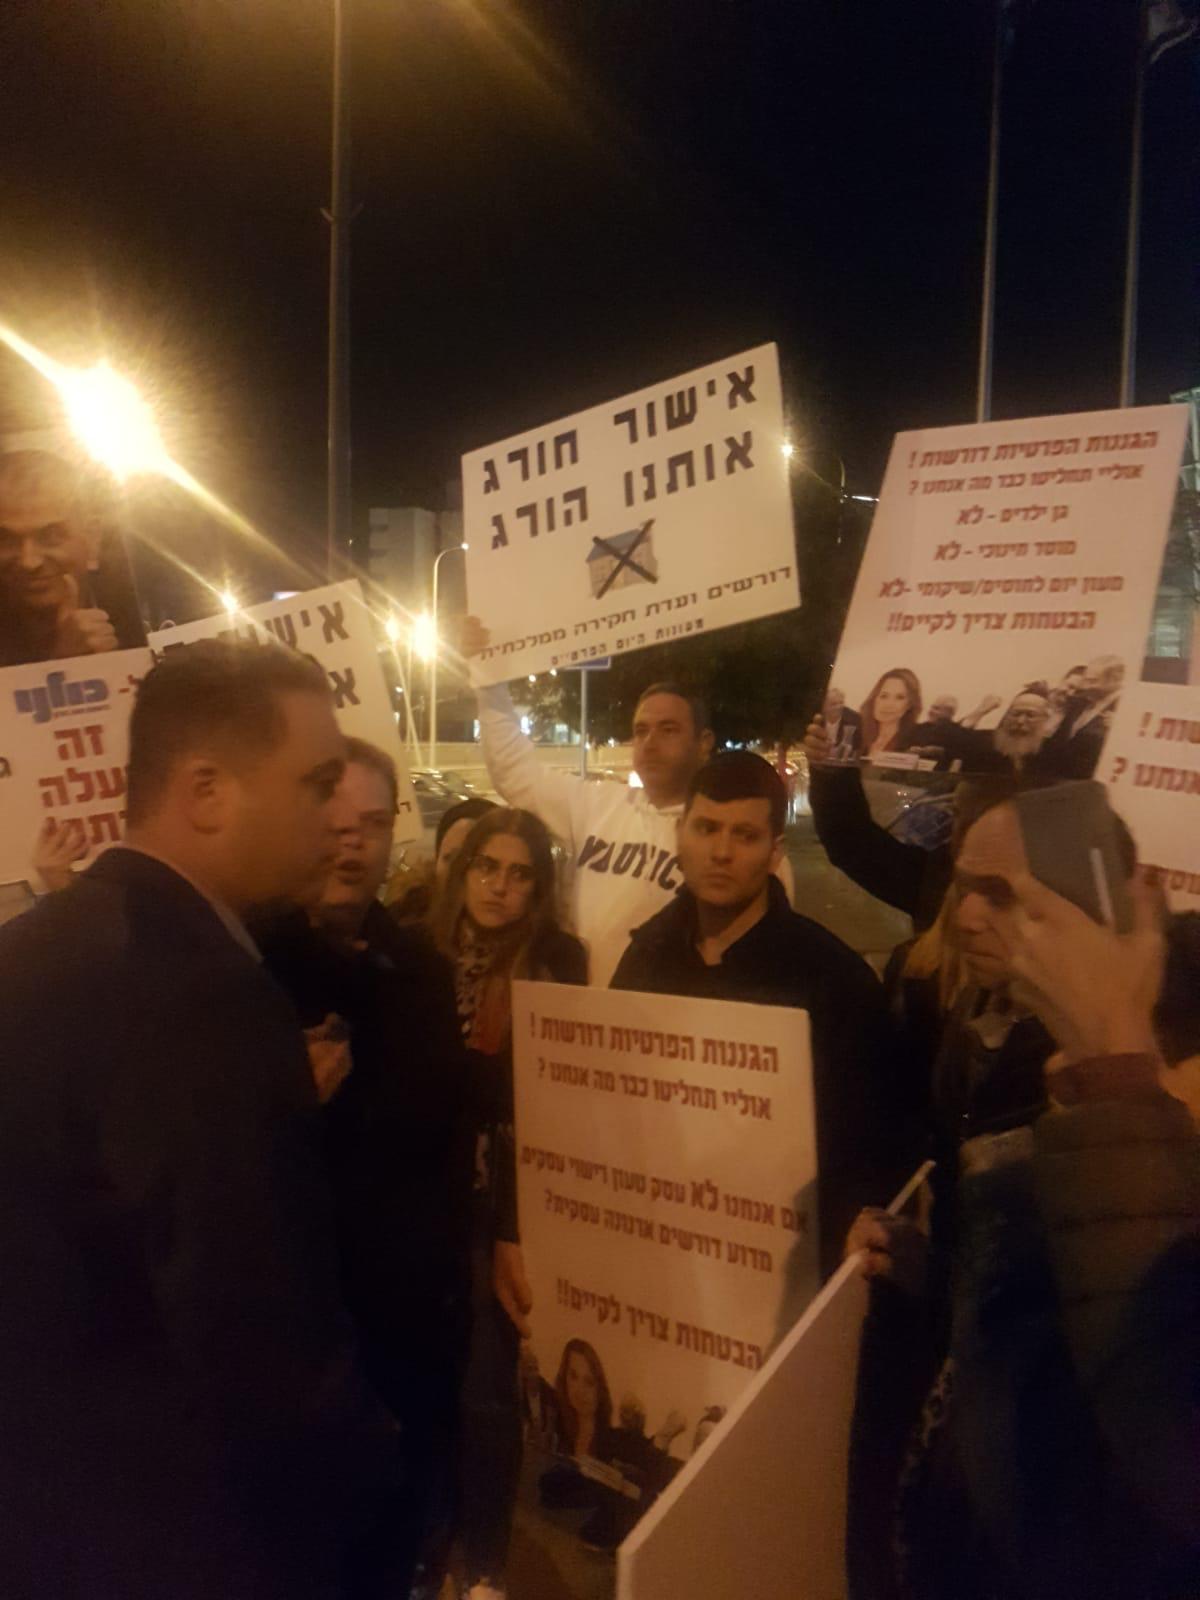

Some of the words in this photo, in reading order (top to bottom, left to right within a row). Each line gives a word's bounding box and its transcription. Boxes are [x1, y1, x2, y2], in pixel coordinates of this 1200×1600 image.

[613, 365, 757, 444] אישור
[994, 437, 1080, 461] הפרטיות
[1084, 430, 1159, 453] הגננות
[483, 429, 579, 494] חורג
[623, 430, 754, 507] אותנו
[919, 445, 991, 468] דורשות
[922, 479, 964, 495] אנחנו
[967, 475, 991, 490] מה
[997, 473, 1026, 489] כבר
[491, 486, 588, 550] הורג
[956, 505, 984, 525] לא
[1000, 505, 1046, 524] ילדים
[1051, 505, 1069, 523] גן
[934, 540, 961, 561] לא
[707, 566, 792, 601] דורשים
[1048, 576, 1076, 593] יום
[1081, 576, 1124, 595] מעון
[645, 593, 697, 618] ועדת
[573, 608, 636, 636] חקירה
[964, 612, 1005, 634] צריך
[1011, 611, 1096, 631] הבטחות
[480, 627, 567, 661] ממלכתית
[54, 724, 104, 761] זה
[38, 766, 128, 808] עלה
[577, 834, 683, 890] NAUTIC
[530, 1012, 536, 1039] !
[541, 1016, 604, 1049] דורשות
[610, 1026, 695, 1062] הפרטיות
[702, 1036, 779, 1075] הגננות
[550, 1061, 589, 1087] אנחנו
[594, 1070, 615, 1092] מה
[620, 1073, 648, 1098] כבר
[653, 1079, 717, 1110] תחליטו
[722, 1088, 772, 1121] אוליי
[520, 1145, 565, 1173] עסקים
[569, 1156, 607, 1184] רישוי
[612, 1166, 646, 1194] טעון
[650, 1176, 685, 1203] עסק
[690, 1177, 718, 1211] לא
[724, 1194, 775, 1226] אנחנו
[604, 1208, 654, 1241] ארנונה
[659, 1223, 722, 1261] דורשים
[727, 1241, 773, 1273] מדוע
[627, 1305, 669, 1342] צריך
[677, 1320, 764, 1371] הבטחות
